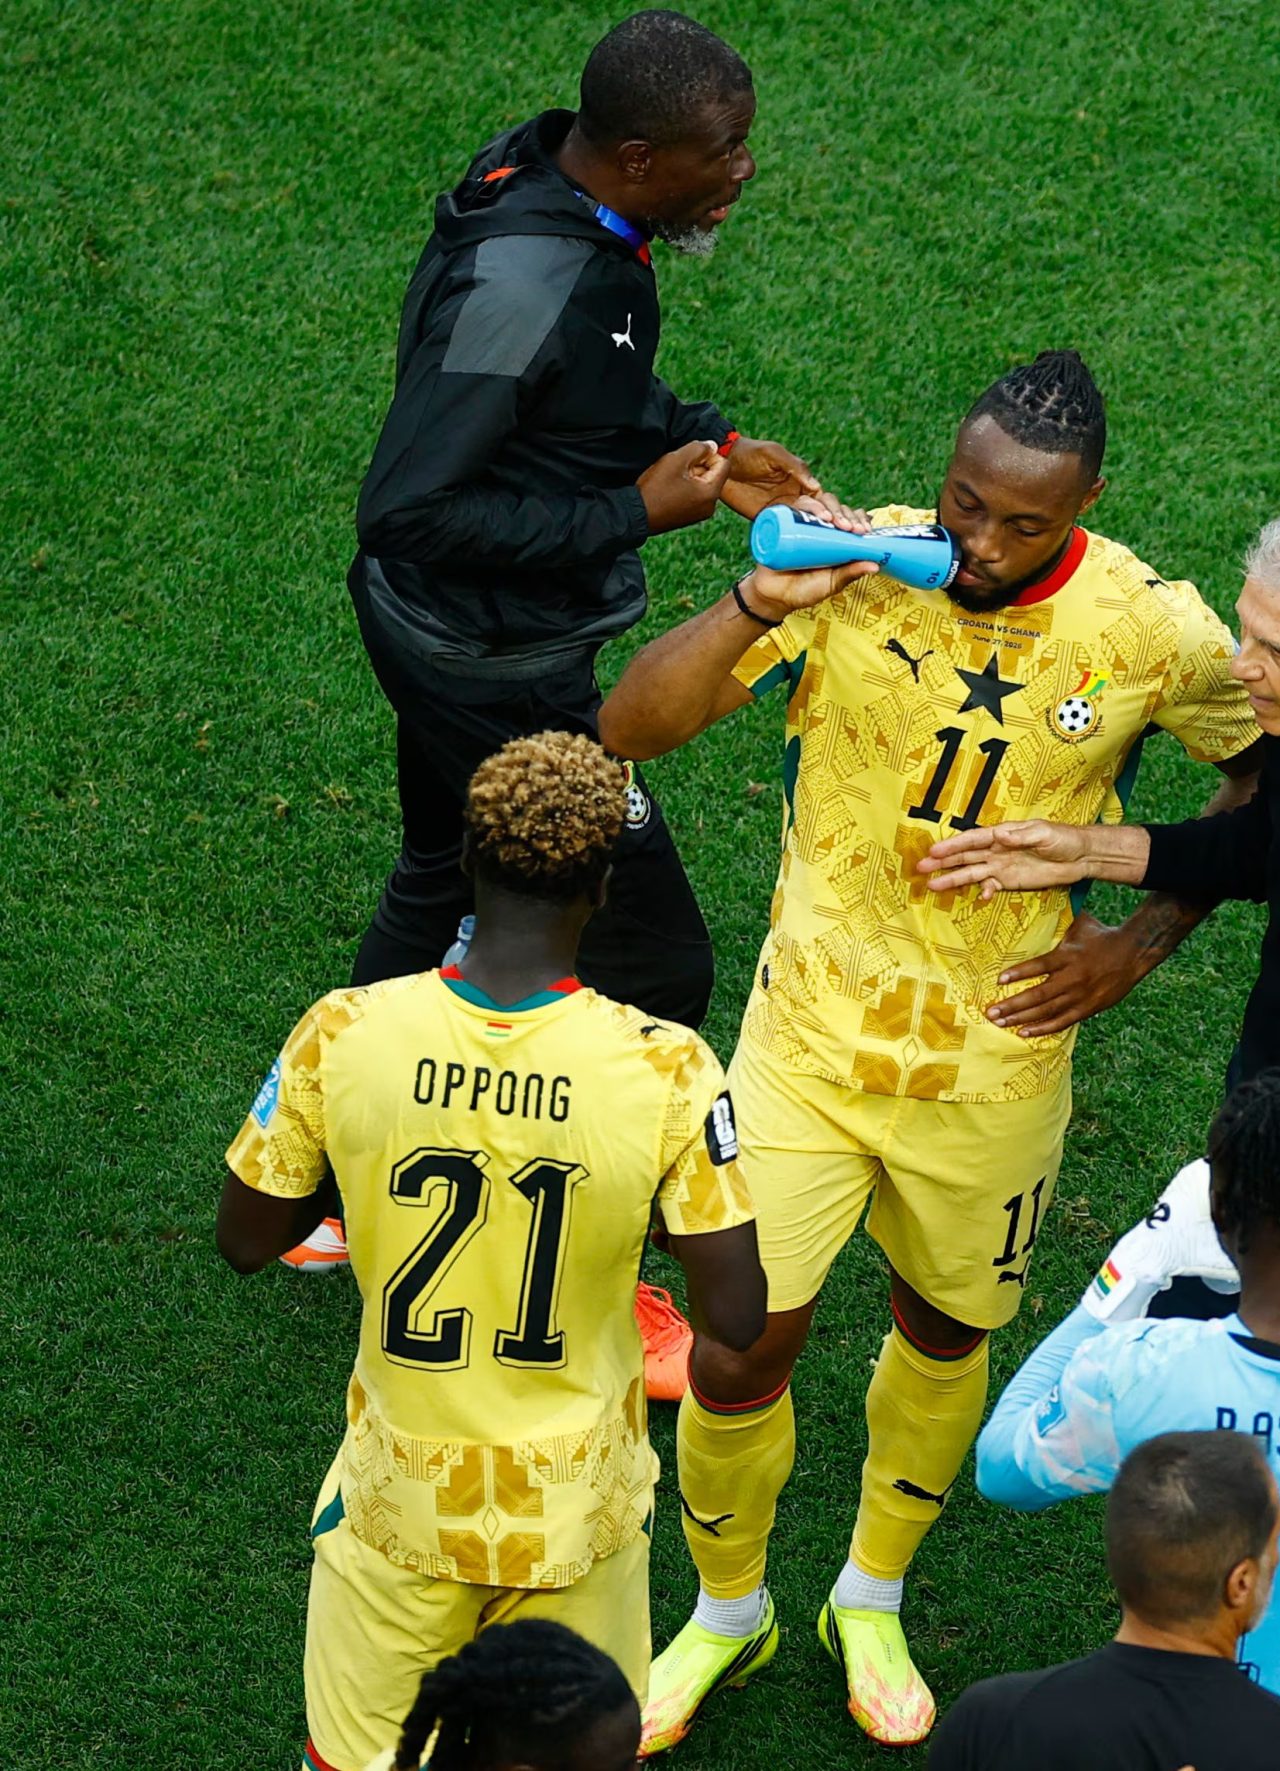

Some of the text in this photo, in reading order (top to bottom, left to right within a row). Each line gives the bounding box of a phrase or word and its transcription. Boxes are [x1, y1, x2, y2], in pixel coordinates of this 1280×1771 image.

[957, 618, 1041, 638] CROATIA VS GHANA
[972, 634, 991, 643] June
[907, 726, 1012, 832] 11
[413, 1057, 572, 1122] OPPONG
[382, 1146, 591, 1372] 21
[992, 1174, 1047, 1266] 11
